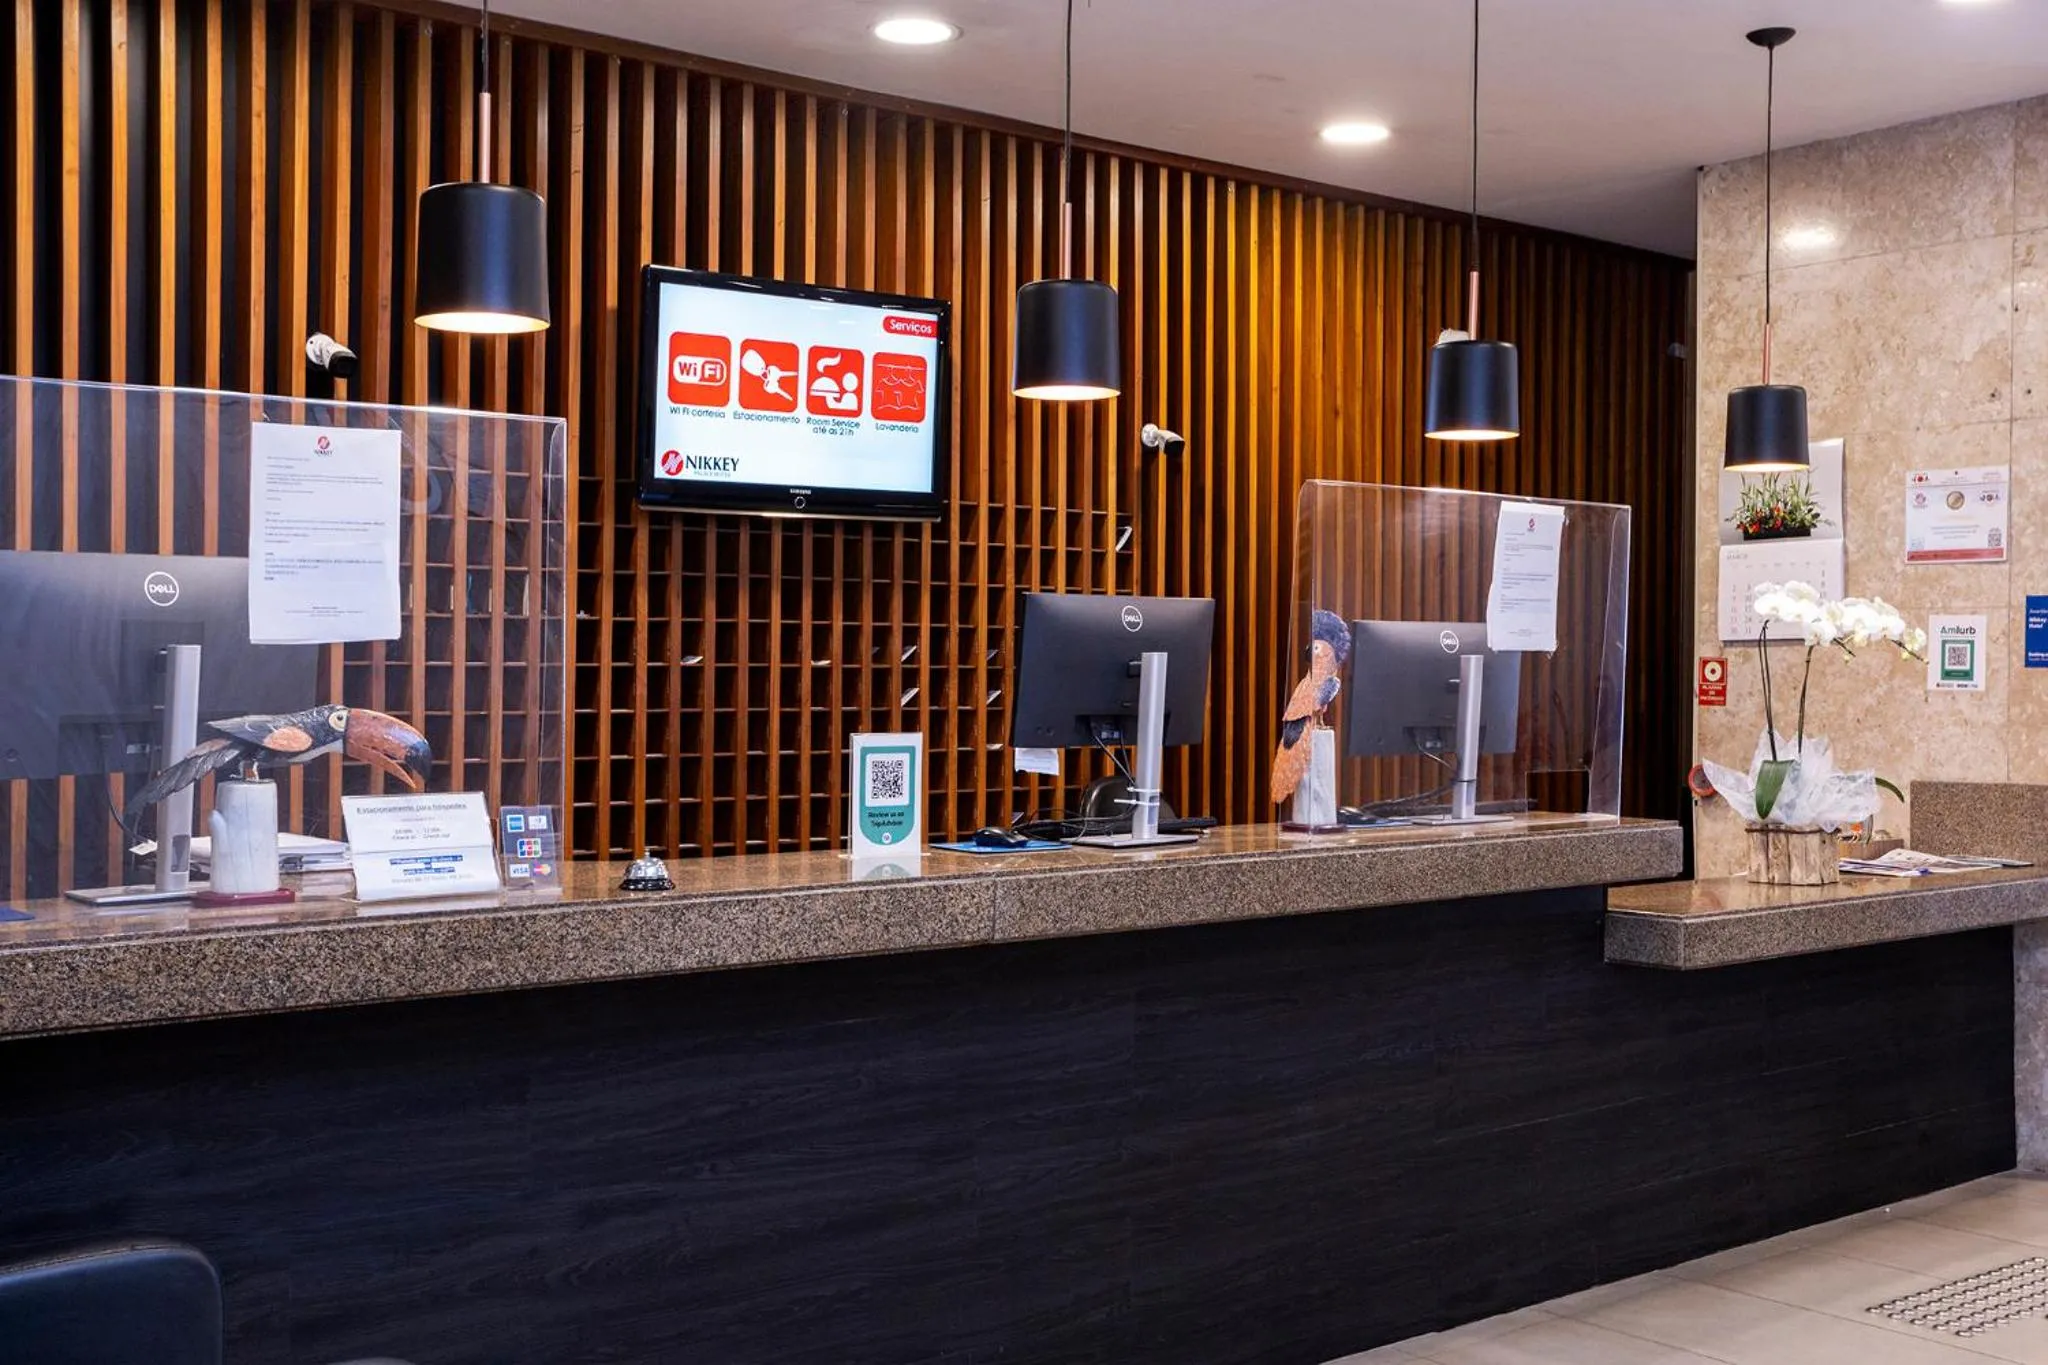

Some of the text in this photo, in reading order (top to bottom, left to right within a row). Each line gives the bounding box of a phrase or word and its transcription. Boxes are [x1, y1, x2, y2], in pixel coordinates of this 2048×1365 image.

[889, 319, 932, 335] Serviços
[733, 410, 801, 424] Estacionamento
[806, 416, 861, 429] Room Service
[875, 422, 919, 433] Lavanderia
[685, 455, 740, 472] NIKKEY
[149, 584, 175, 593] DELL
[1940, 625, 1977, 635] Amlurb
